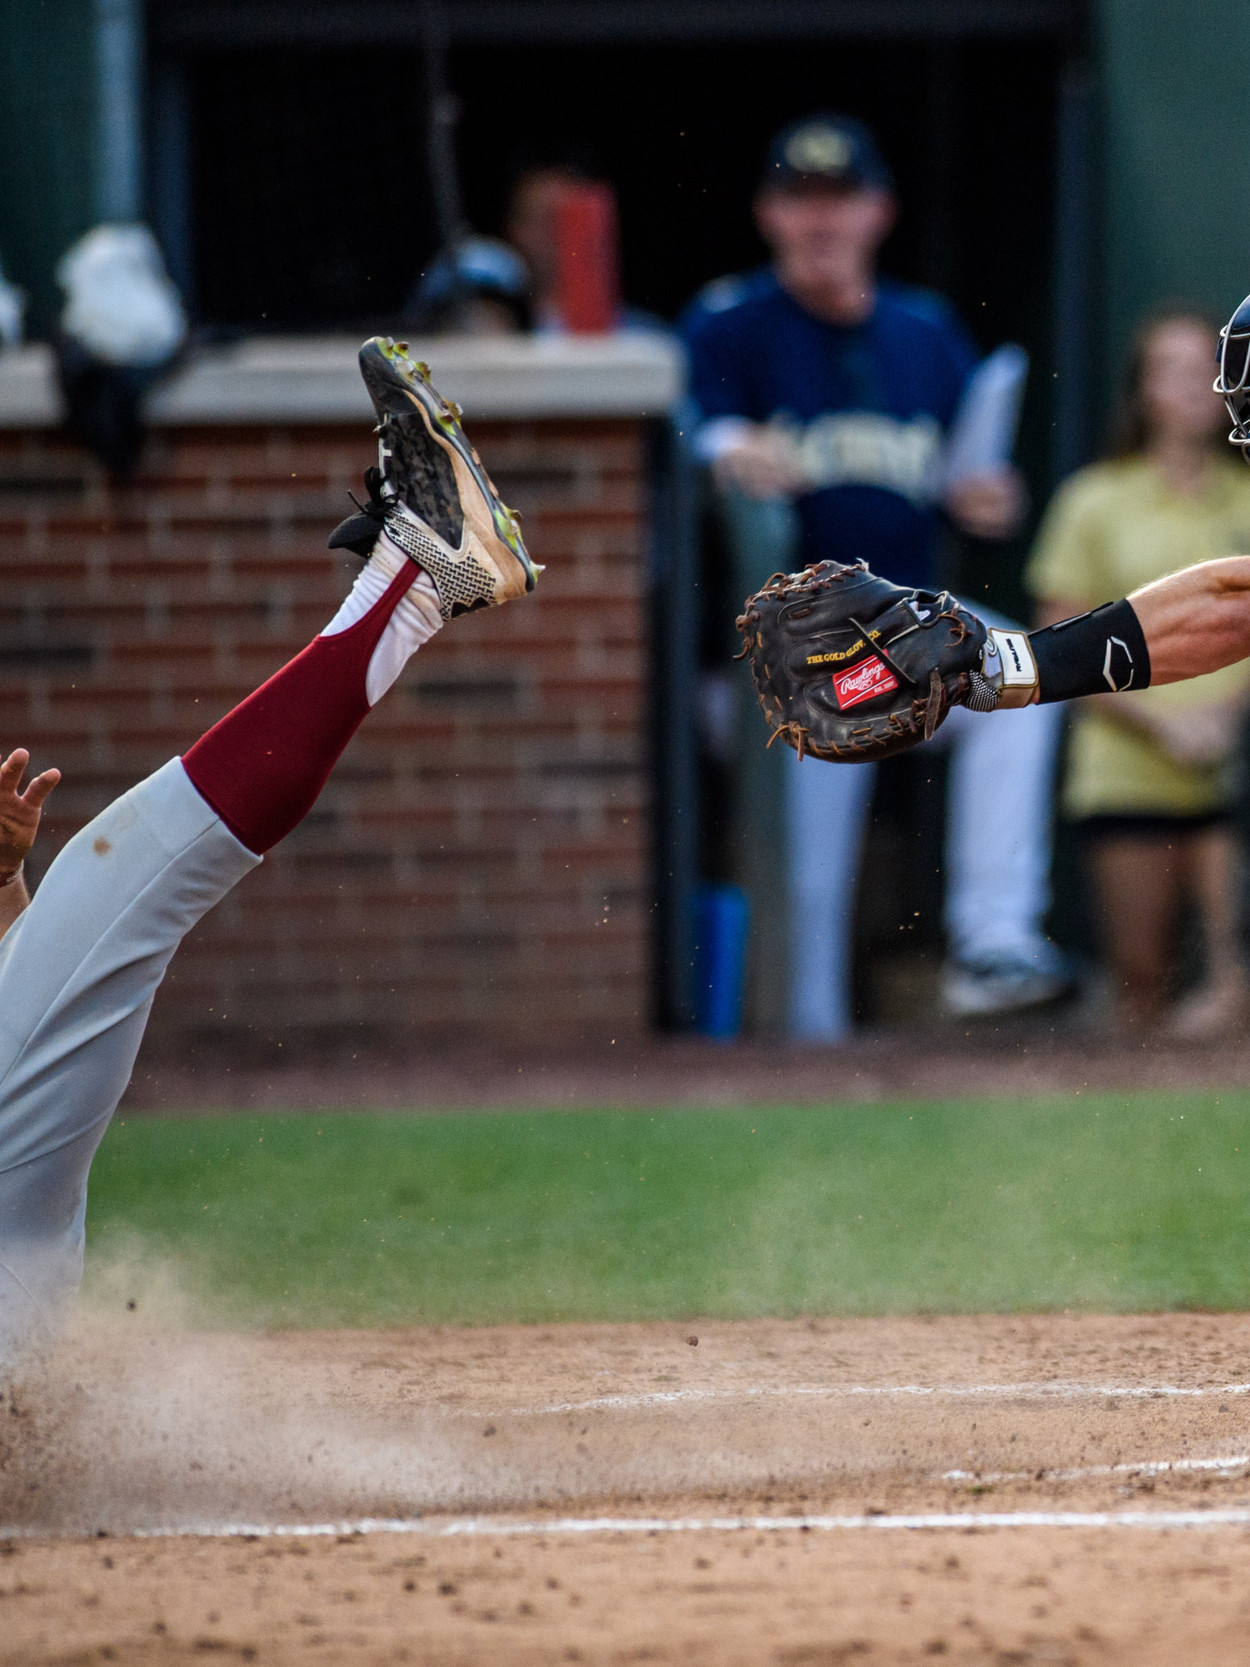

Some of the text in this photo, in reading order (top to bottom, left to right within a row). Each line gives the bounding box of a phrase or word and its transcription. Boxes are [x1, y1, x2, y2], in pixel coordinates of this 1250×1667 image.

[806, 654, 823, 664] THE
[824, 652, 845, 662] GOLD
[846, 640, 866, 657] GLOV
[841, 662, 885, 694] Rawlings
